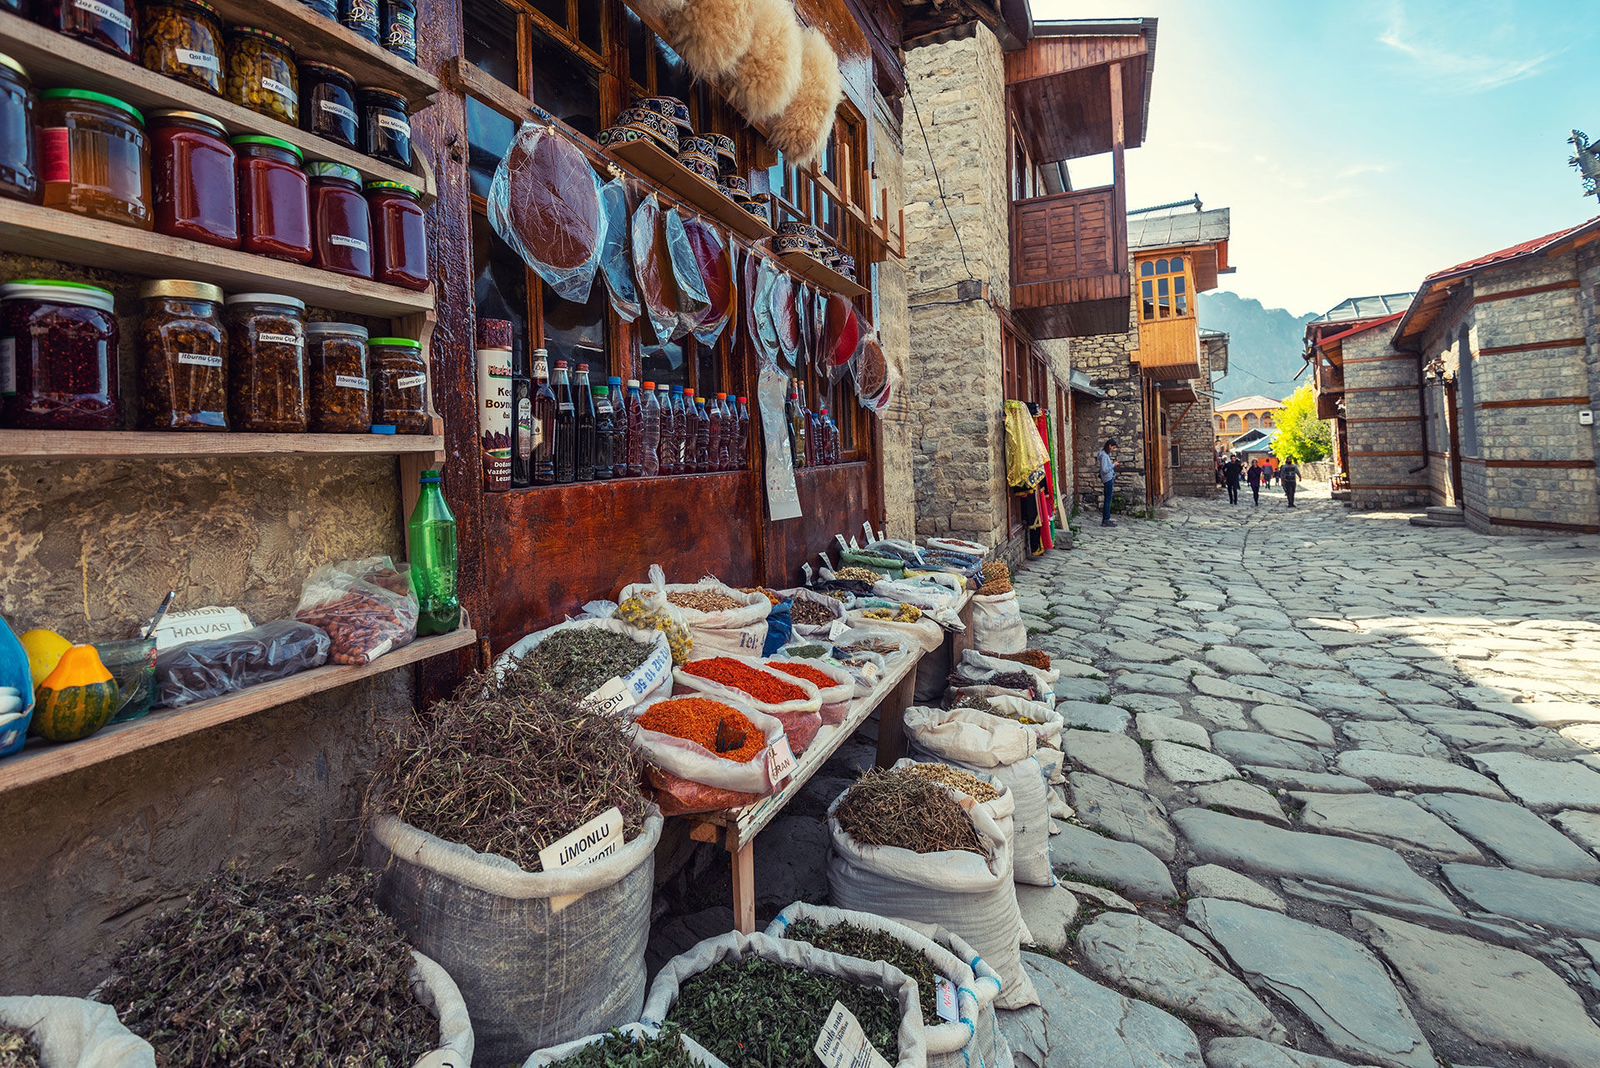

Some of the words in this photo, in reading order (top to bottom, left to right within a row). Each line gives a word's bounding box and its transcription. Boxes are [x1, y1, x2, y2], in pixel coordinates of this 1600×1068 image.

[497, 387, 512, 397] Ke
[485, 399, 512, 410] Boyn
[173, 622, 232, 638] HALVASI
[559, 823, 610, 866] LİMONLU
